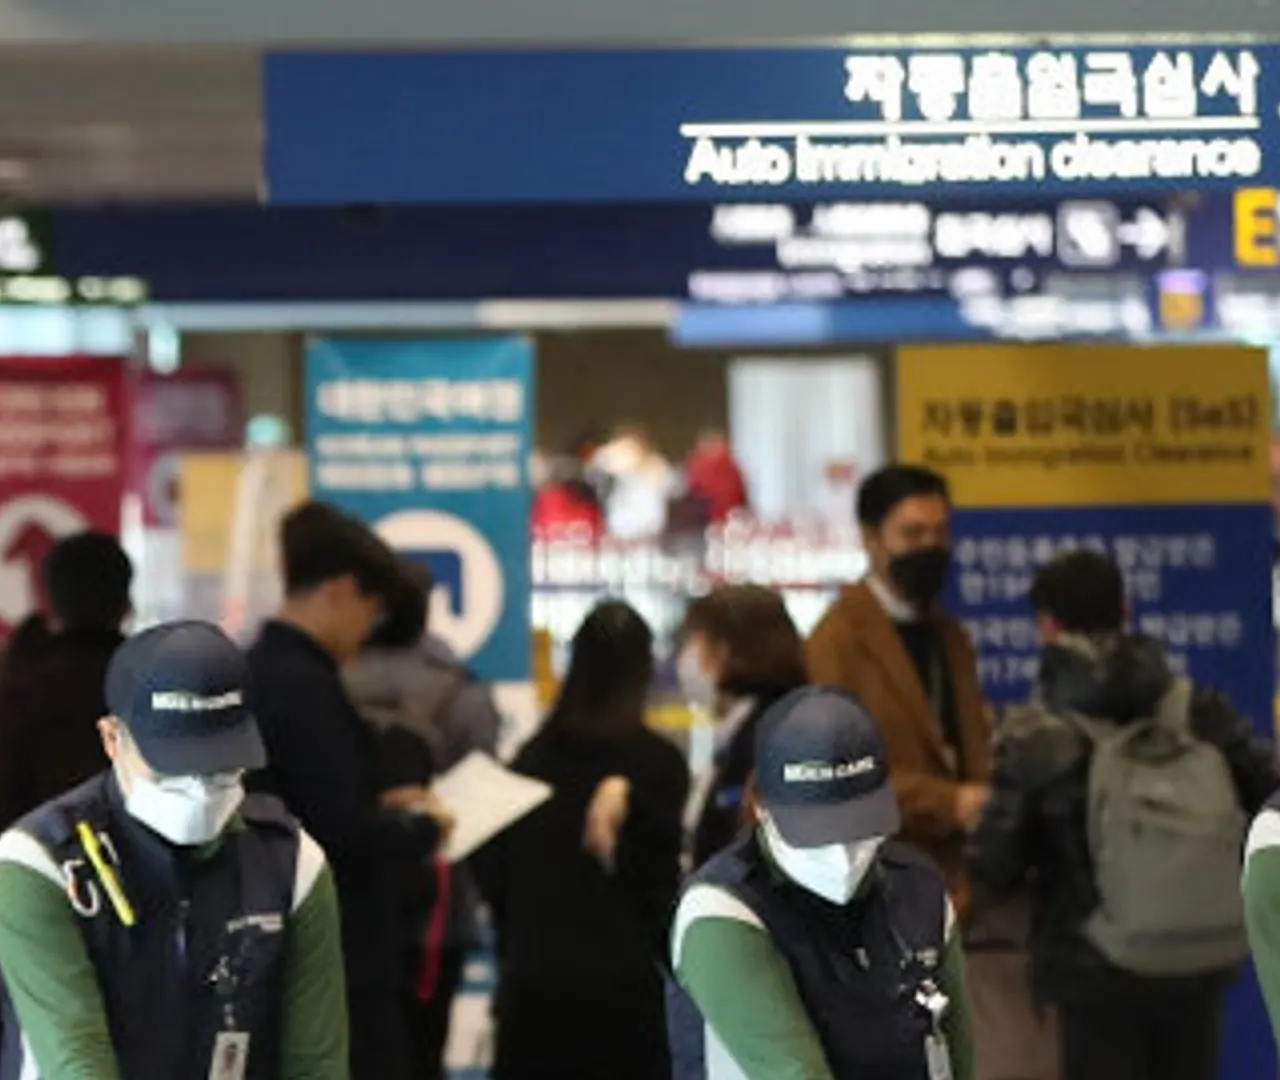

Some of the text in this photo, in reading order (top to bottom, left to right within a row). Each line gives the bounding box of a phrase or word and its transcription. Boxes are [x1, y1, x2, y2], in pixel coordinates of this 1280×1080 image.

[684, 137, 791, 185] Auto
[1050, 131, 1261, 180] clearance
[1233, 187, 1280, 267] E
[923, 395, 1156, 437] 자동출입국심사
